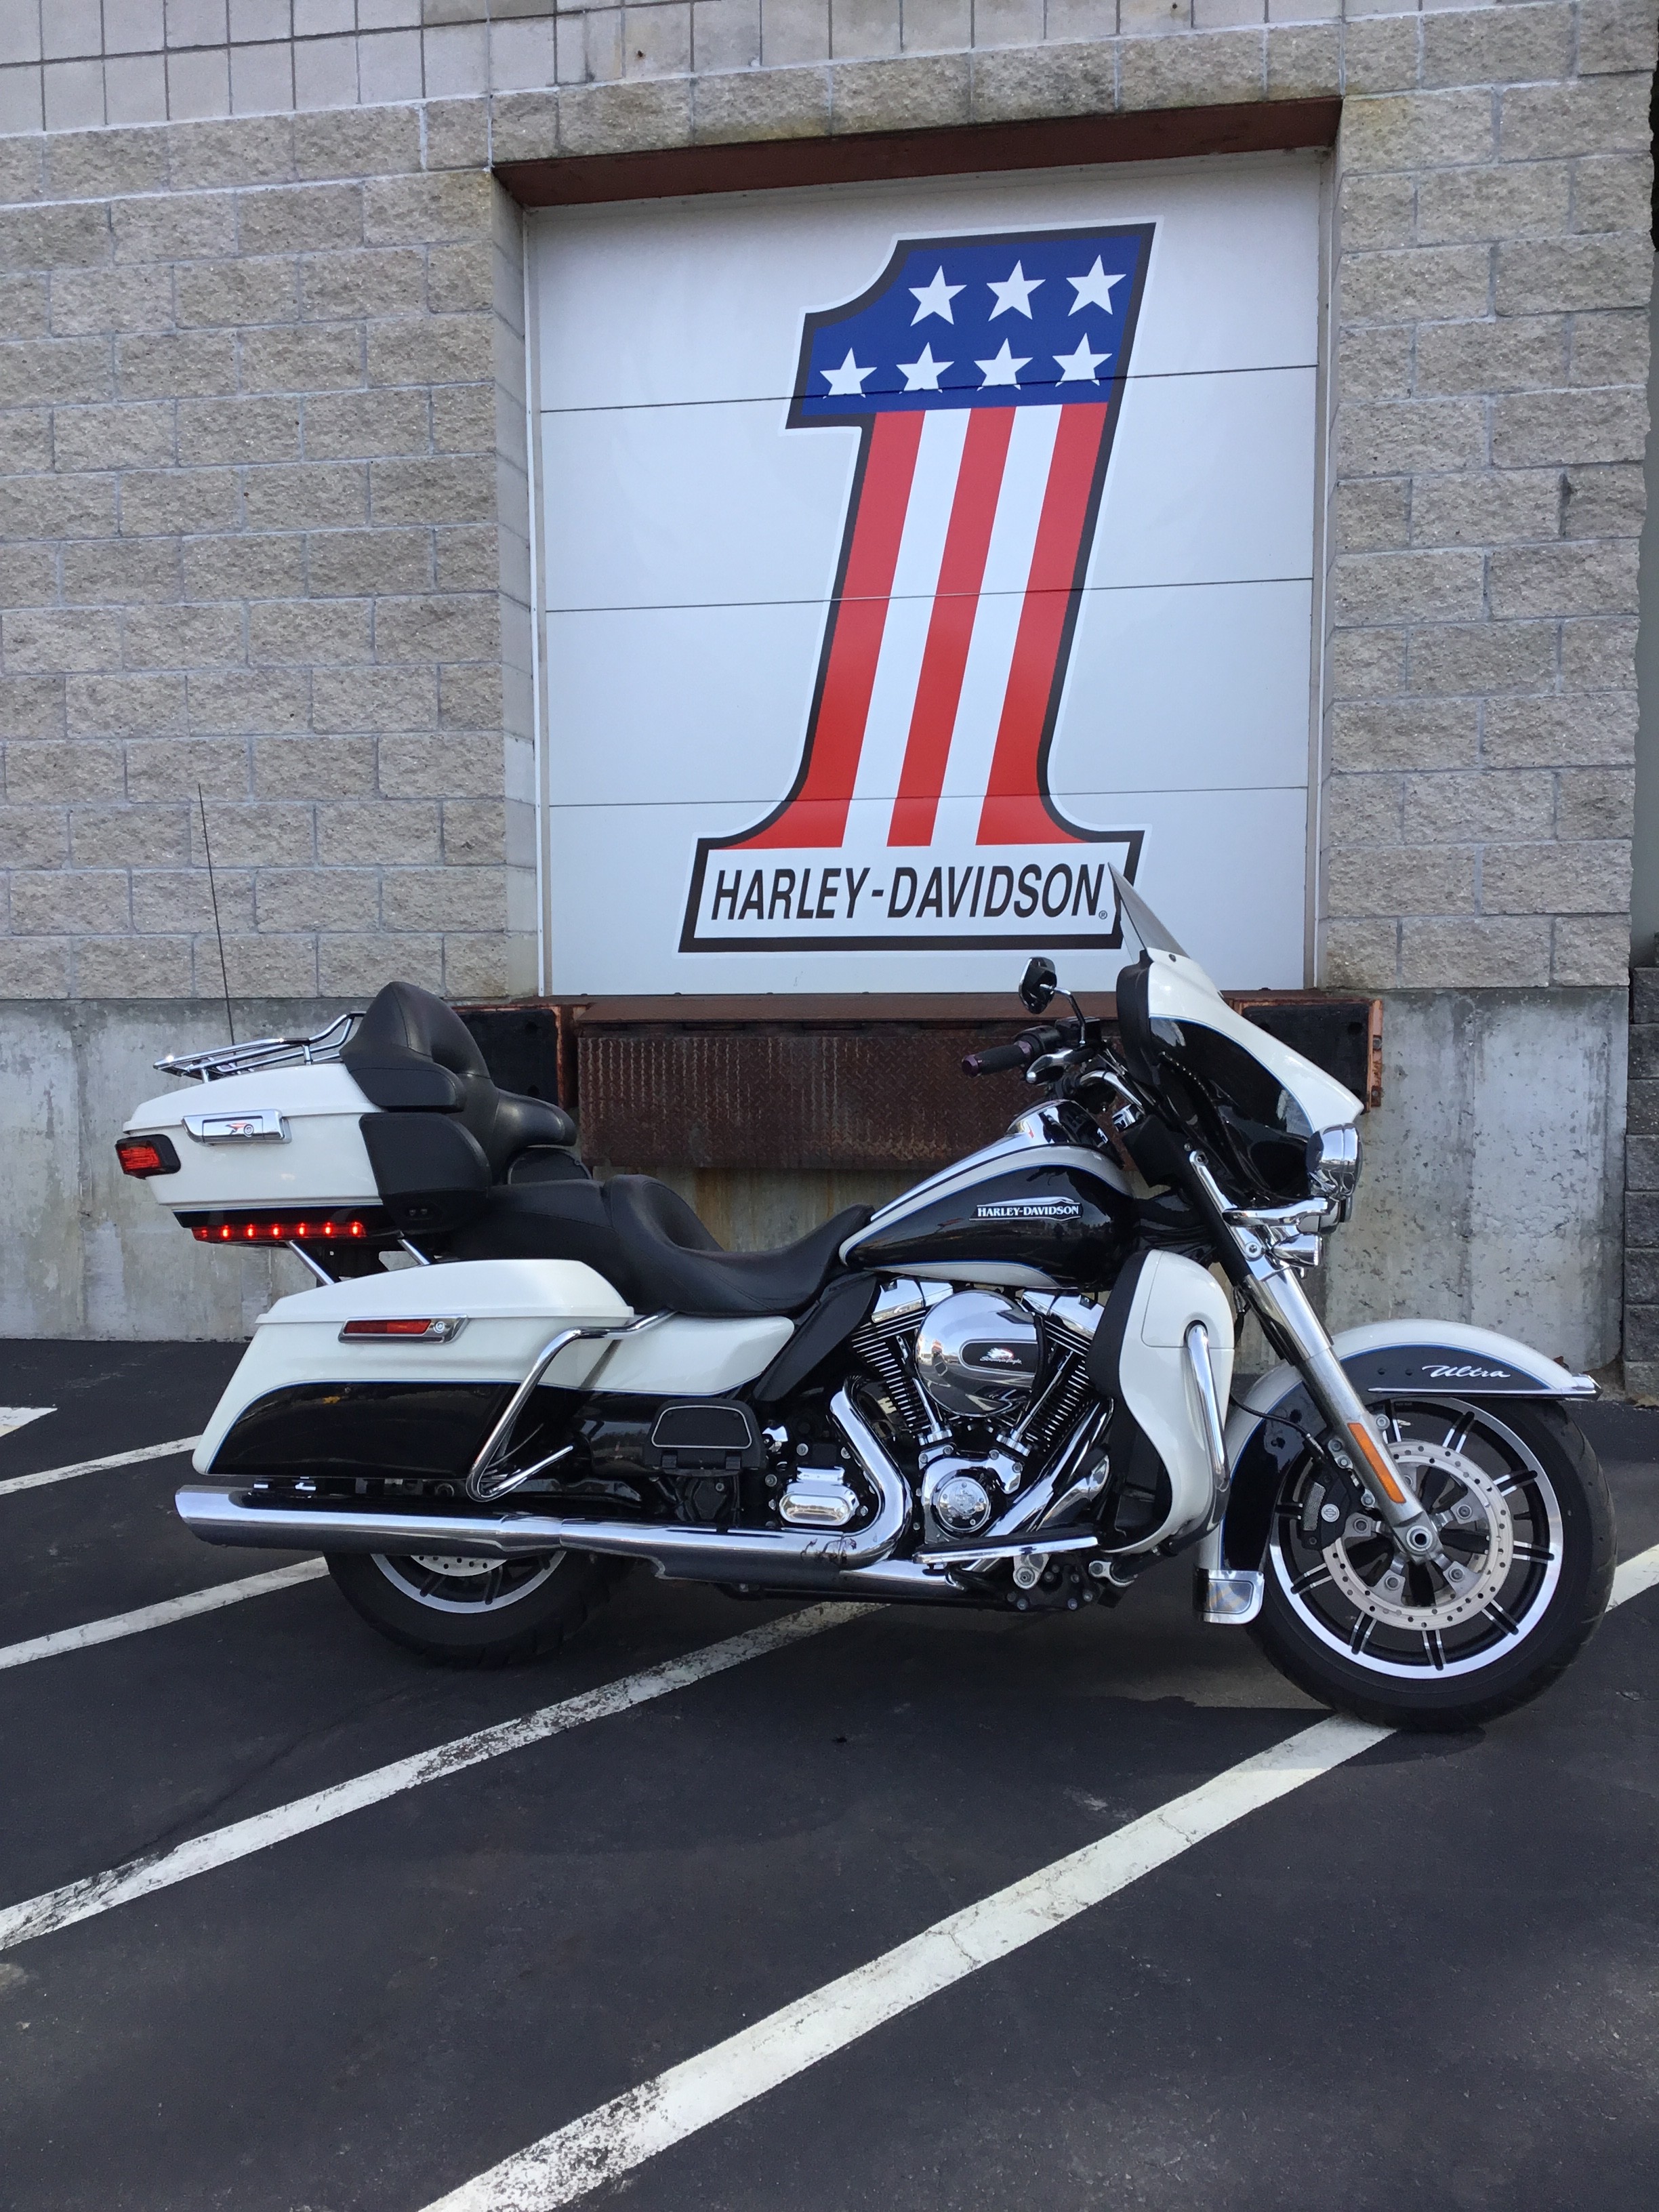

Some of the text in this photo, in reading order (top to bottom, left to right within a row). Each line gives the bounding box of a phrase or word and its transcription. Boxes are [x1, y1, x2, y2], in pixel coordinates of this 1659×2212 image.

[711, 863, 1105, 920] HARLEY-DAVIDSON
[977, 1206, 1079, 1216] HARLEY-DAVIDSON
[1421, 1364, 1511, 1378] Ultra
